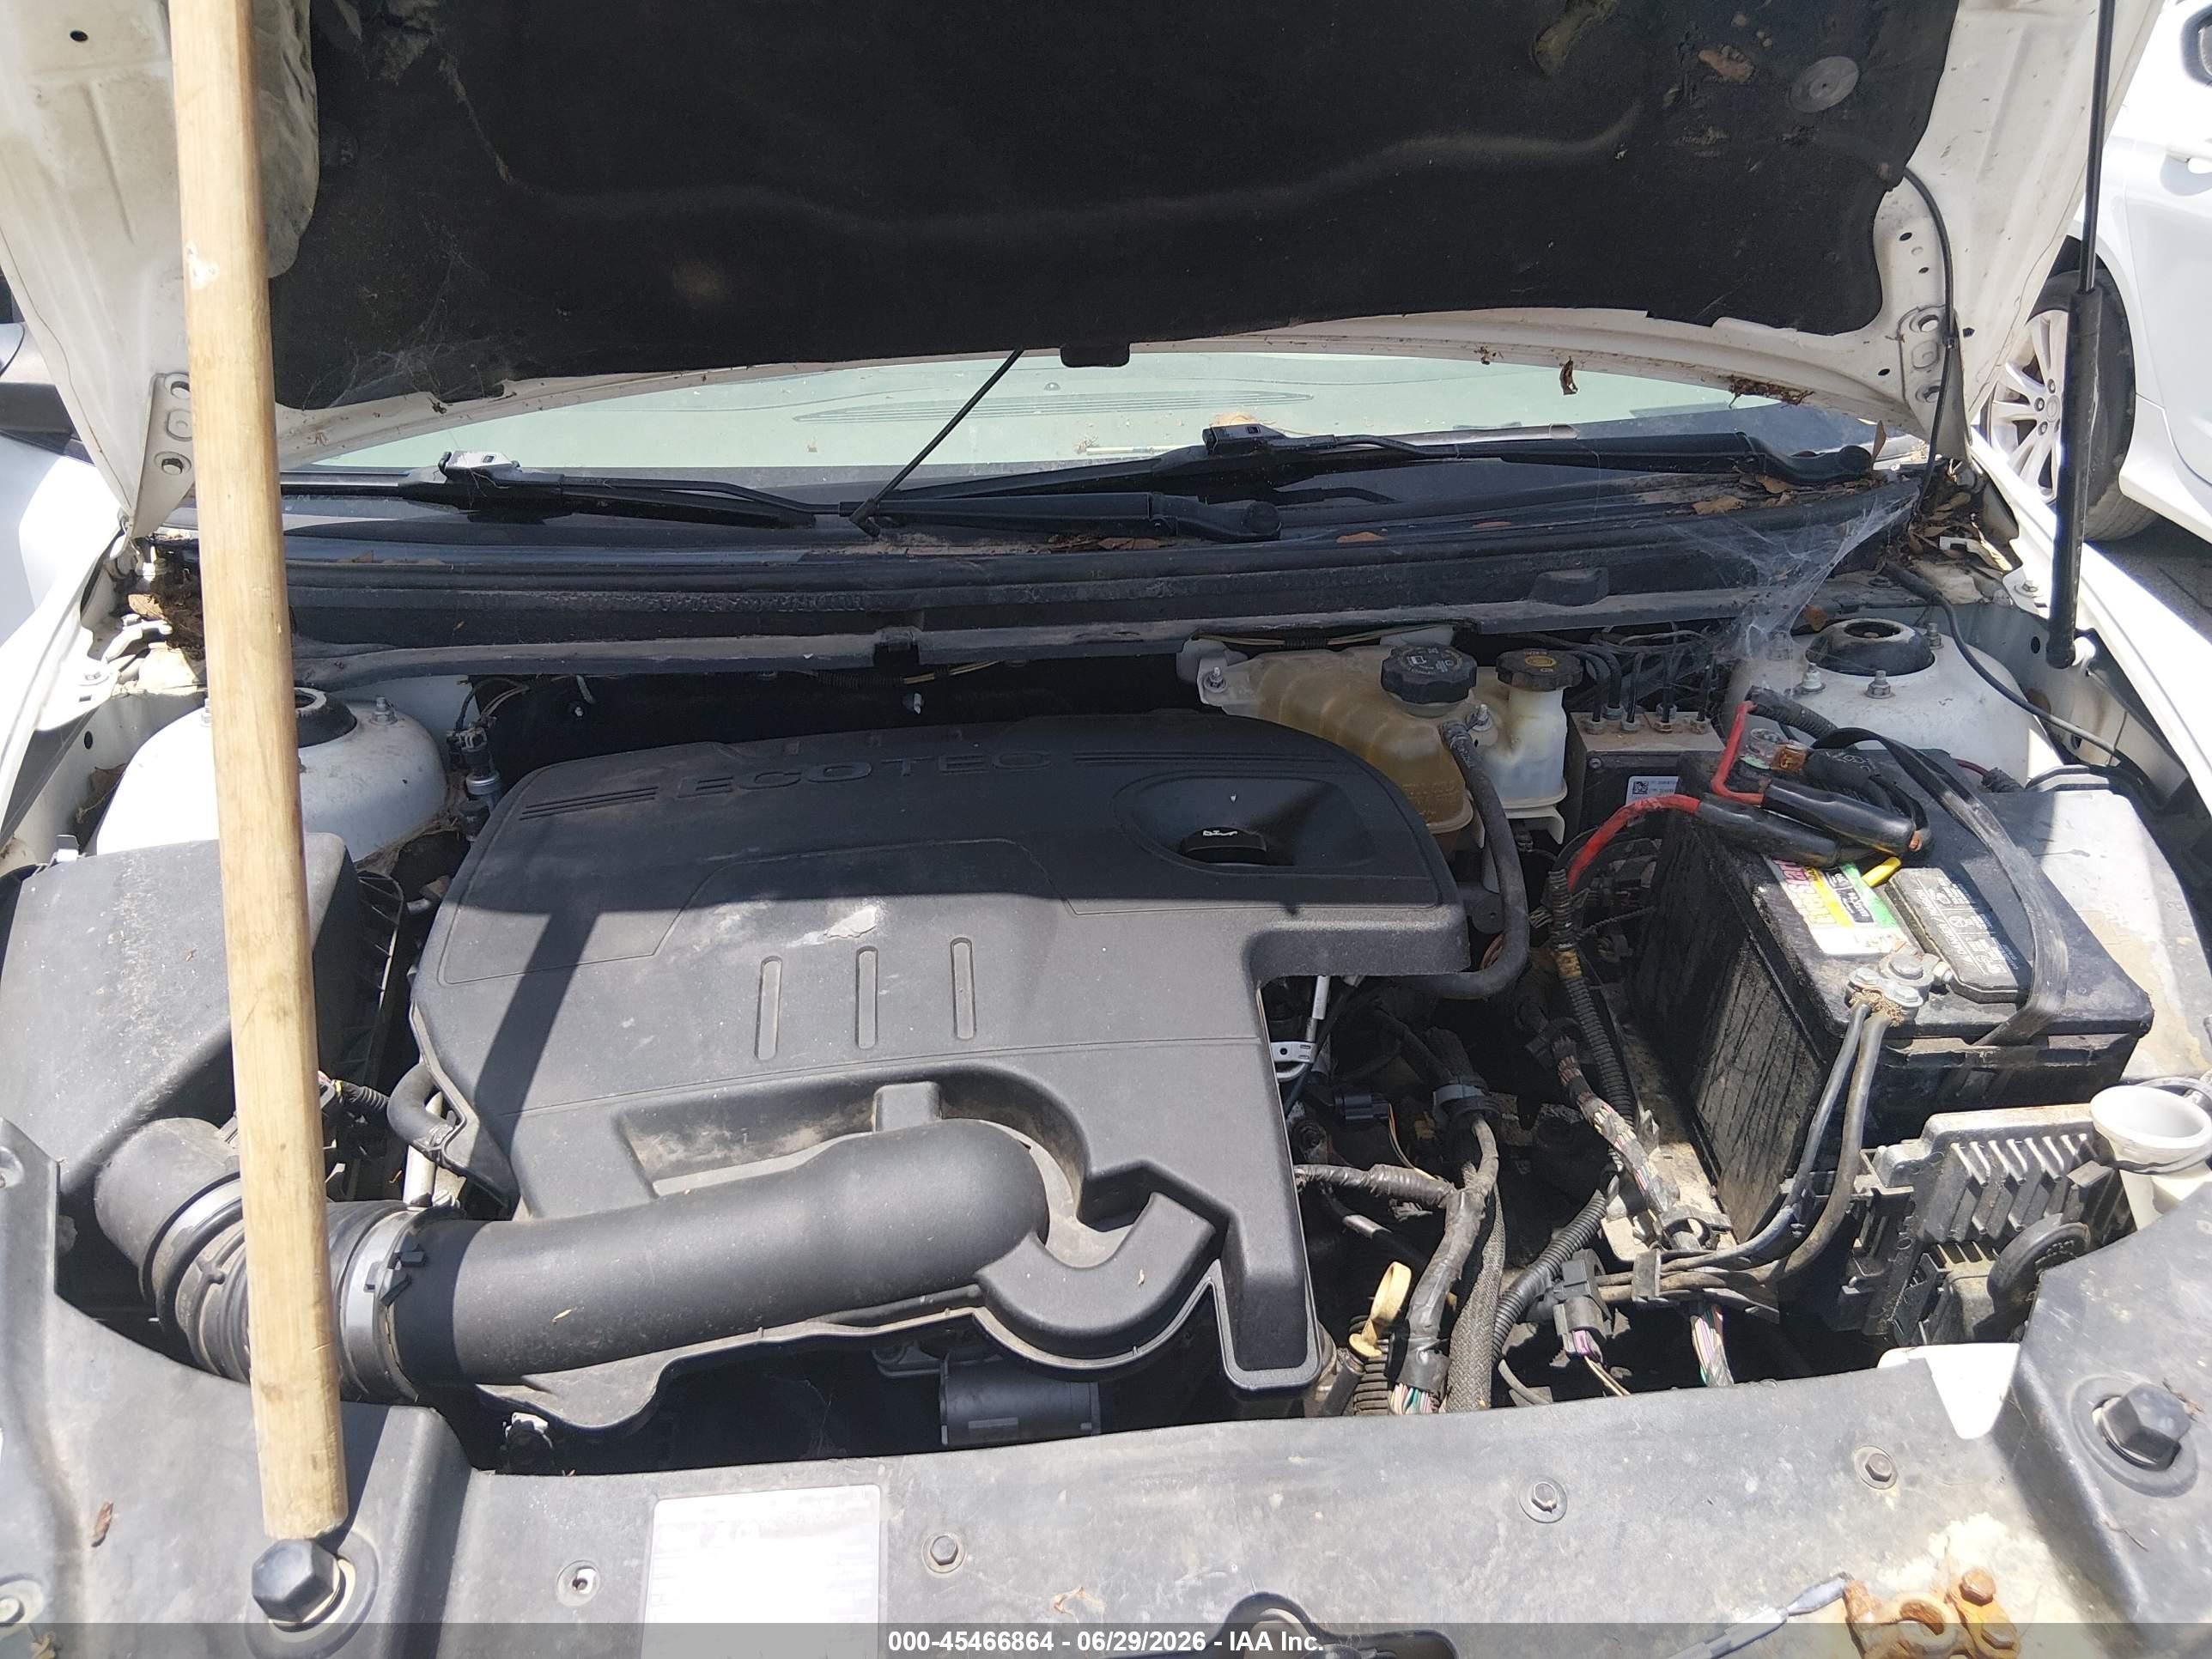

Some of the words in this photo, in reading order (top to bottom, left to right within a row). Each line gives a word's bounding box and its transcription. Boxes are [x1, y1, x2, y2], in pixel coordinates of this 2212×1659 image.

[678, 750, 1052, 799] ECOTEC
[1914, 889, 1942, 917] POISON
[1937, 923, 1967, 956] DANGER
